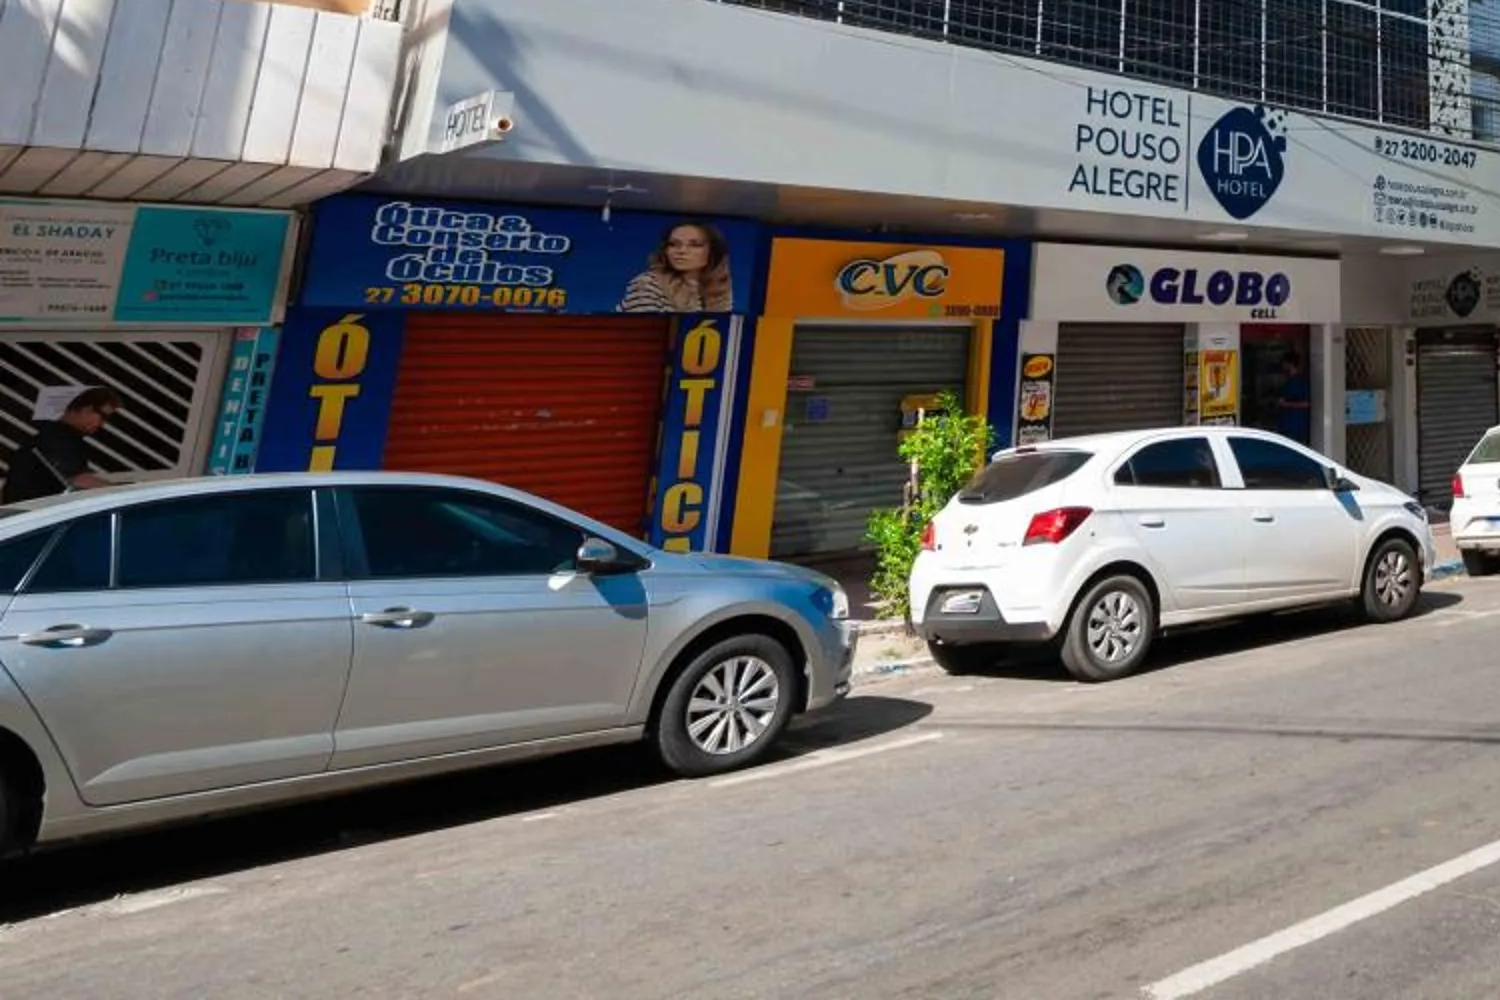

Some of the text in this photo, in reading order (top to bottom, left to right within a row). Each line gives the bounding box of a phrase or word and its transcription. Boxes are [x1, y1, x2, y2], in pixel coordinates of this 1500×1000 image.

[446, 104, 487, 141] HOTEL
[1087, 86, 1180, 127] HOTEL
[1076, 124, 1180, 163] POUSO
[1214, 128, 1272, 179] HPA
[1384, 139, 1477, 168] 27 3200-2047
[1068, 164, 1180, 202] ALEGRE
[1217, 179, 1267, 198] HOTEL
[12, 223, 116, 239] EL SHADAY
[372, 224, 571, 253] Conserto
[386, 253, 554, 286] Óculos
[427, 246, 488, 265] de
[840, 260, 949, 297] CVC
[1150, 267, 1290, 307] GLOBO
[364, 283, 567, 308] 27 3070-0076
[1251, 308, 1277, 319] CELL
